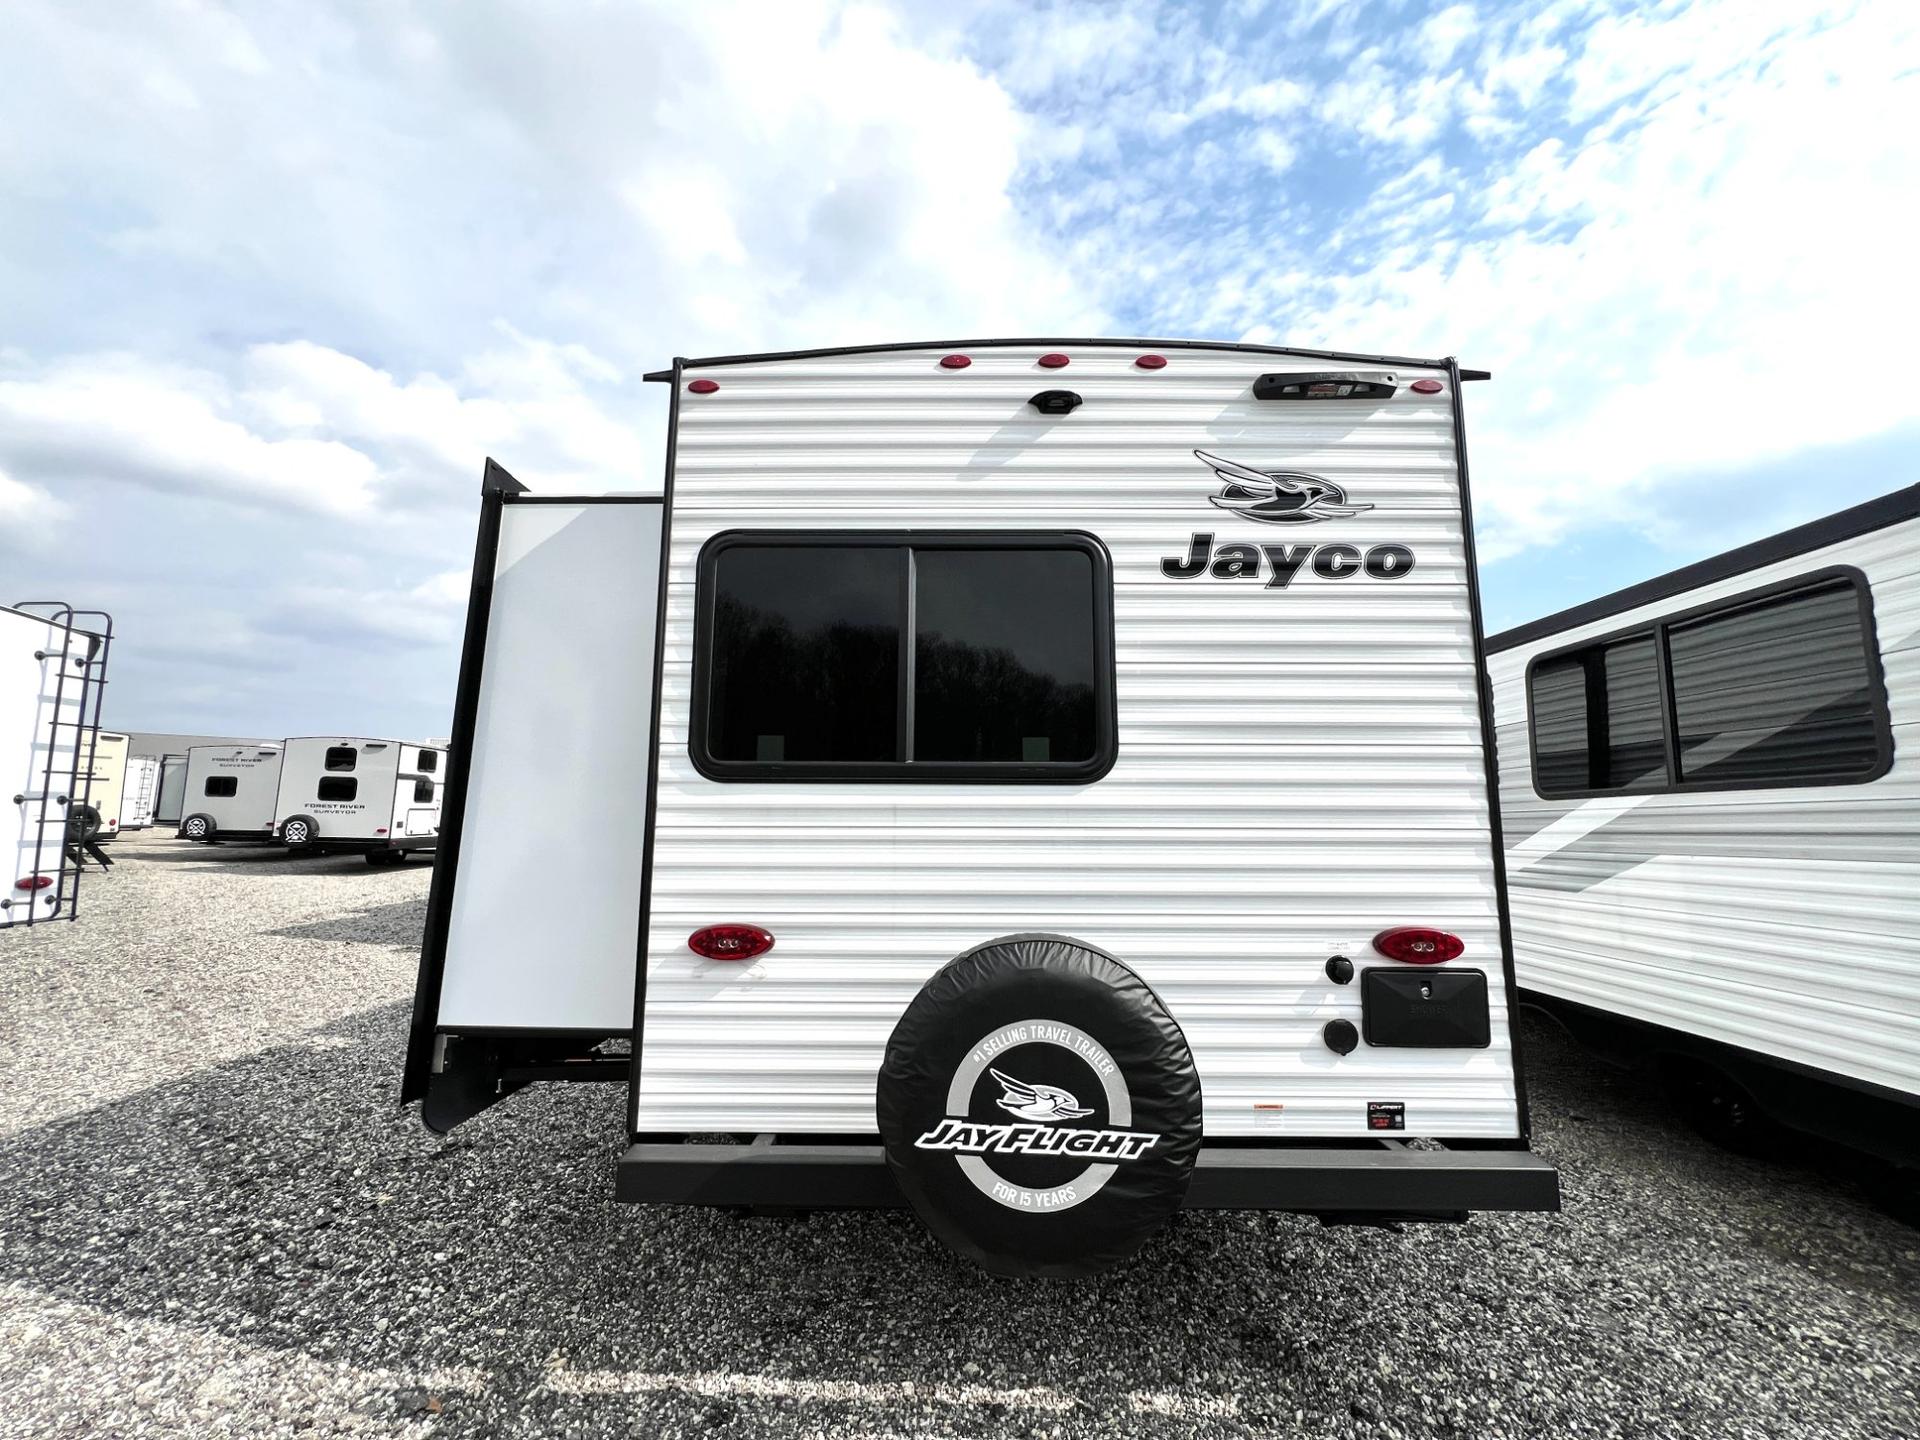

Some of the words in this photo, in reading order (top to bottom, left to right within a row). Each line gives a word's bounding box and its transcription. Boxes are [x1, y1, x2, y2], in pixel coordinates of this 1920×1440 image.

[1160, 532, 1415, 590] Jayco
[973, 1049, 986, 1063] #1
[983, 1027, 1027, 1056] SELLING
[1030, 1025, 1071, 1045] TRAVEL
[1074, 1035, 1115, 1077] TRAILER
[992, 1181, 1017, 1203] FOR
[1020, 1191, 1031, 1206] 15
[1035, 1186, 1076, 1207] YEARS
